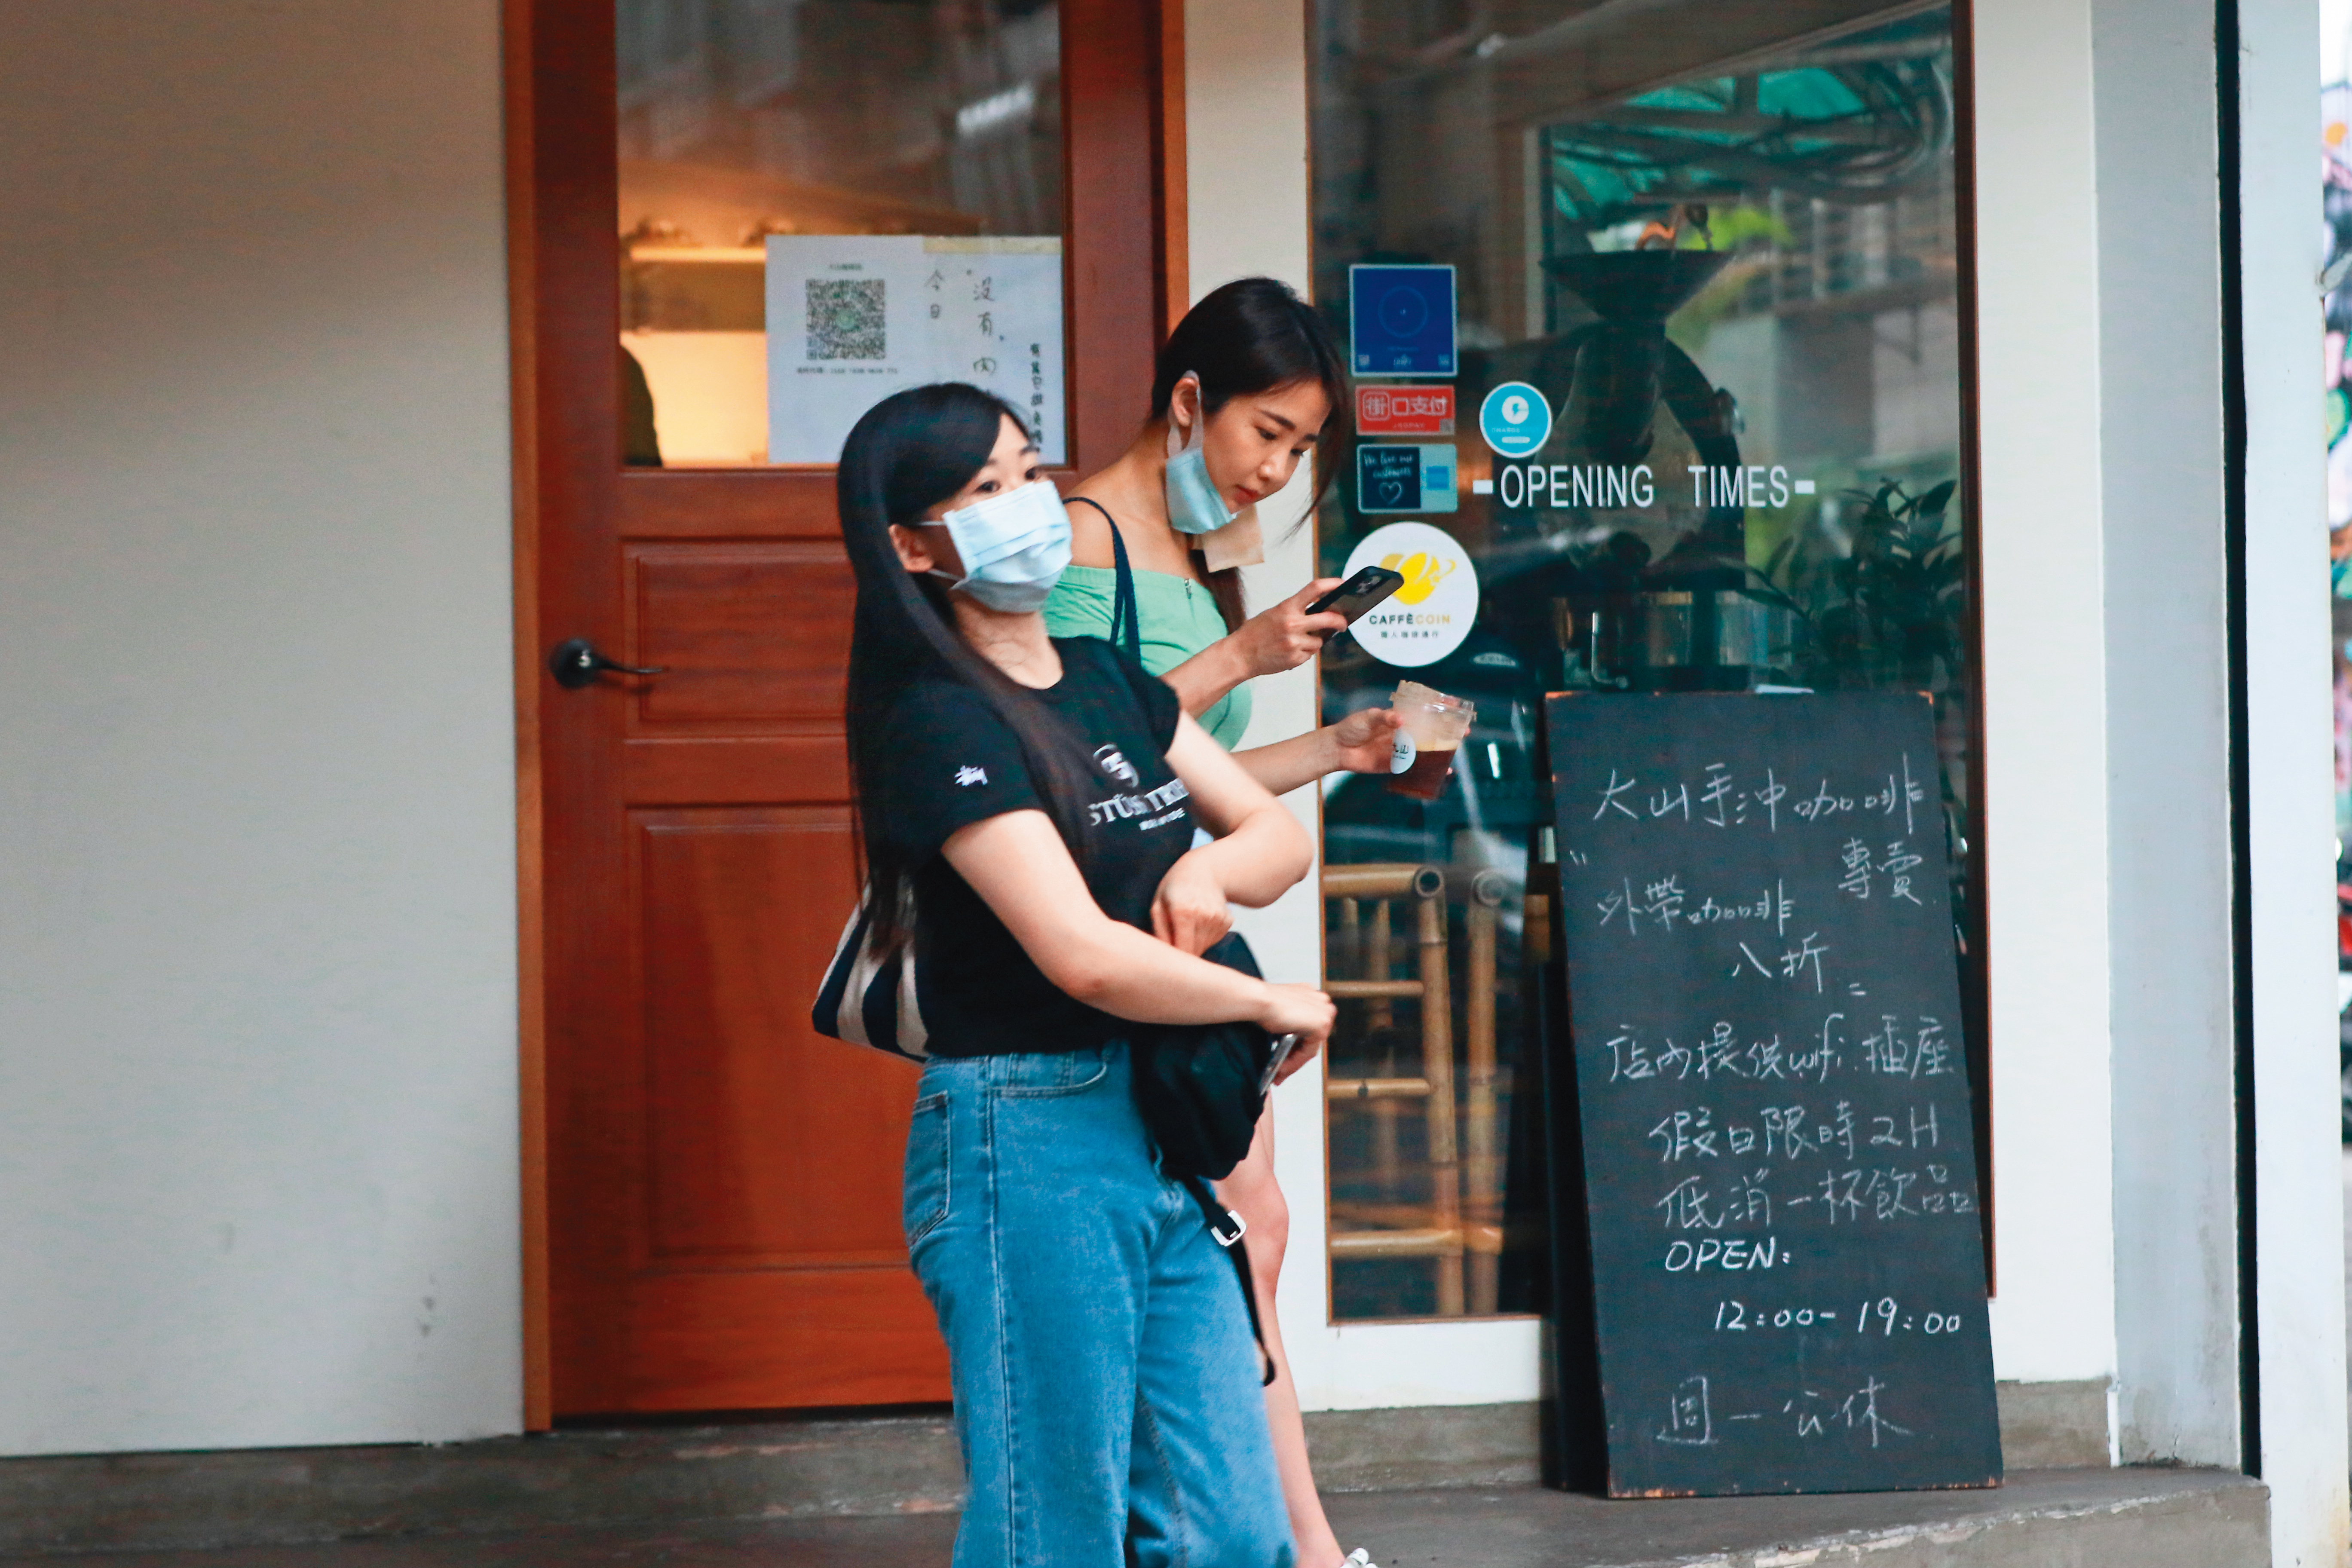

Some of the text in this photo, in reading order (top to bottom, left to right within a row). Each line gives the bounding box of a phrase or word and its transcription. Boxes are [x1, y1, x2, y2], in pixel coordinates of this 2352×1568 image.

[1501, 465, 1788, 508] OPENING TIMES
[1665, 1236, 1791, 1271] OPEN:
